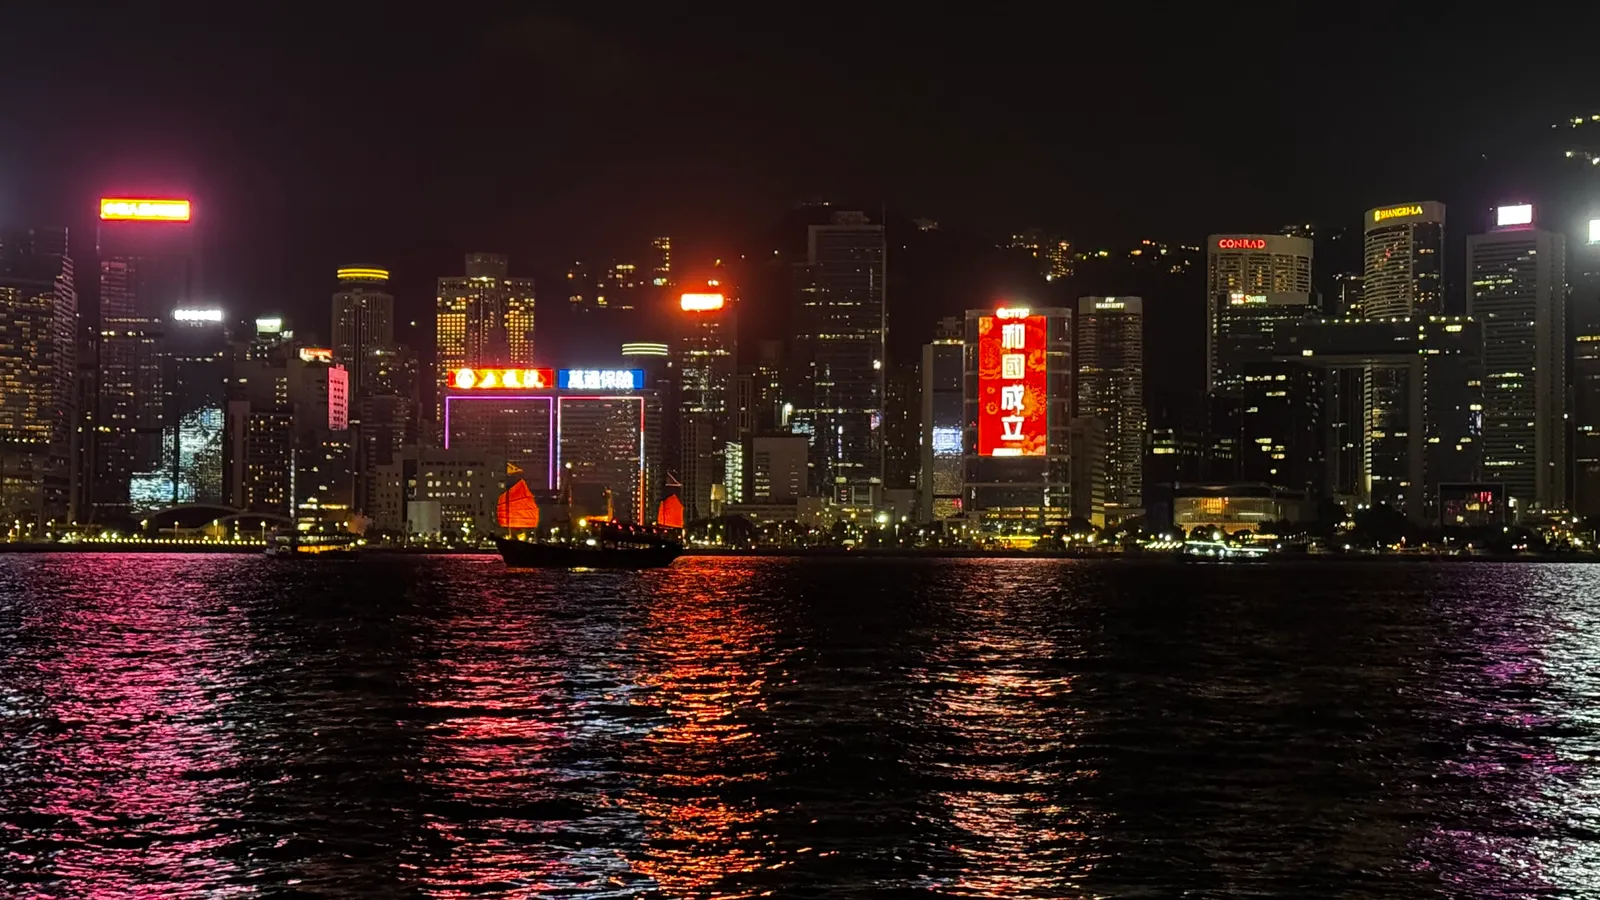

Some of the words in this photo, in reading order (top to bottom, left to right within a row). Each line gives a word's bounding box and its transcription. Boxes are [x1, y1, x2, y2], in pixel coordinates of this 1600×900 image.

[1218, 239, 1266, 249] CONRAD
[1096, 302, 1125, 310] MARRIOTT
[1001, 324, 1025, 441] 和國成立
